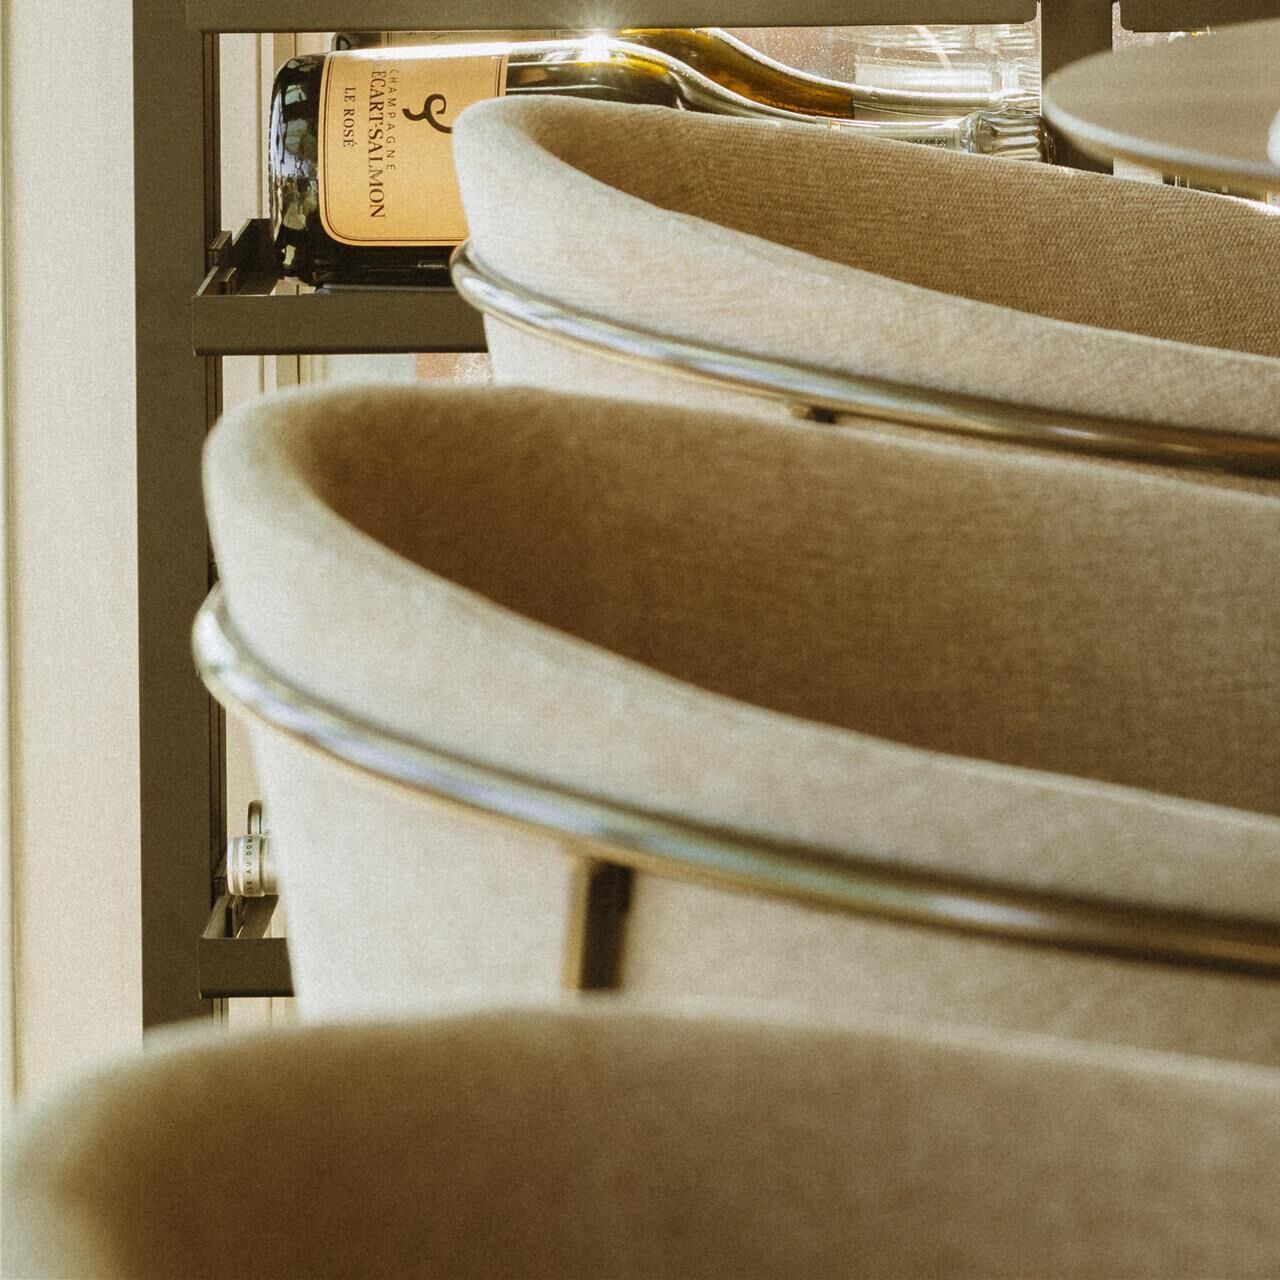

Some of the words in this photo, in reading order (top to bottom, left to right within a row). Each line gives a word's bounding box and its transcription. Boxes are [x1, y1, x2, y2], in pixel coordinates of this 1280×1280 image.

[343, 87, 357, 102] LE
[343, 108, 357, 149] ROSÉ
[386, 69, 399, 171] CHAMPAGNE
[367, 64, 388, 220] ECART-SALMON
